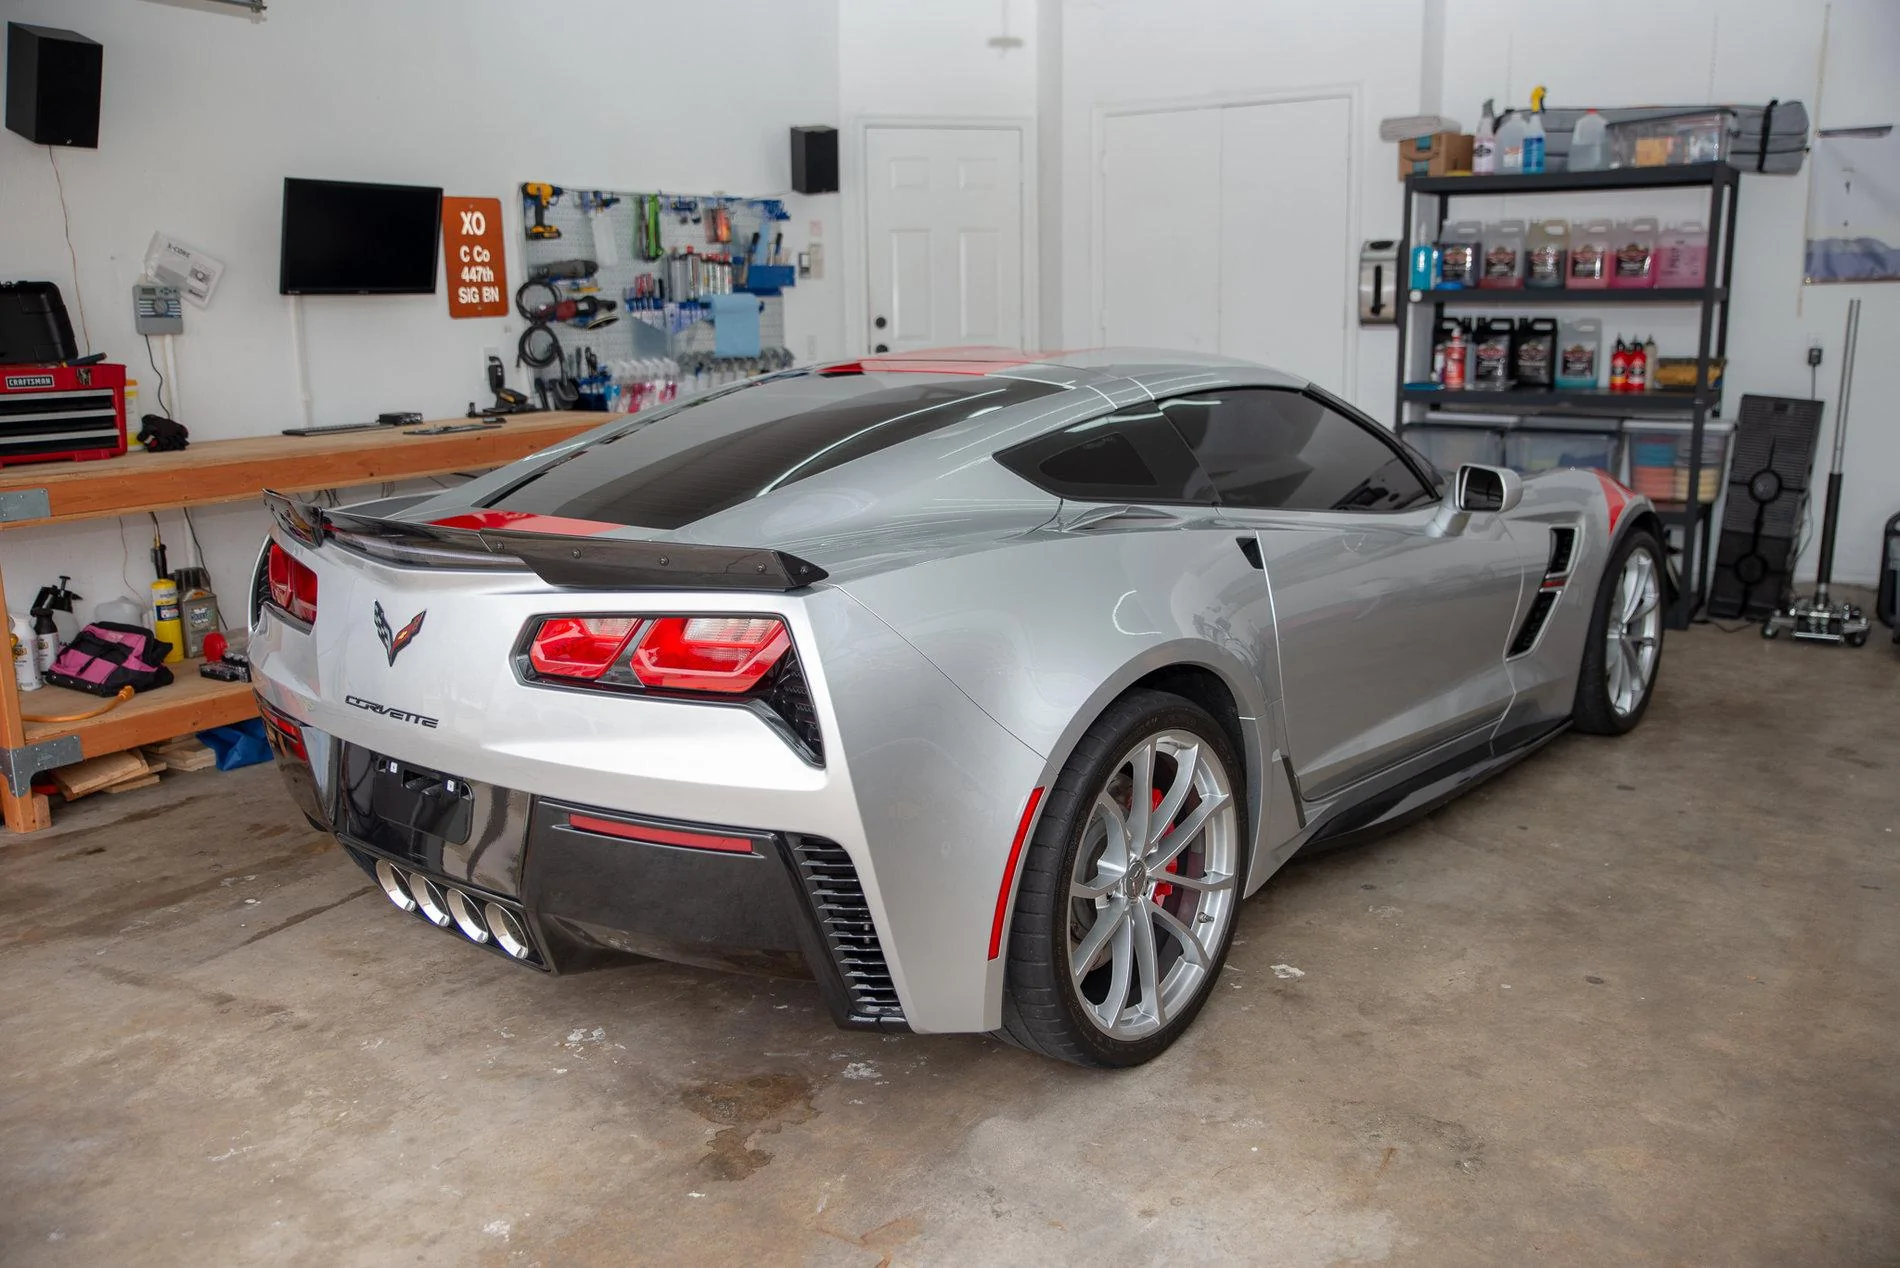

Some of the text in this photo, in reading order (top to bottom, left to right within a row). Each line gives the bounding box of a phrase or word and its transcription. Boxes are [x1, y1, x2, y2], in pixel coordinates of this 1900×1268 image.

[460, 211, 485, 235] XO
[460, 245, 490, 262] C Co
[461, 265, 495, 283] 447th
[458, 286, 500, 304] SIG BN
[9, 377, 52, 387] CRAFTSMAN
[345, 695, 439, 729] CORVETTE
